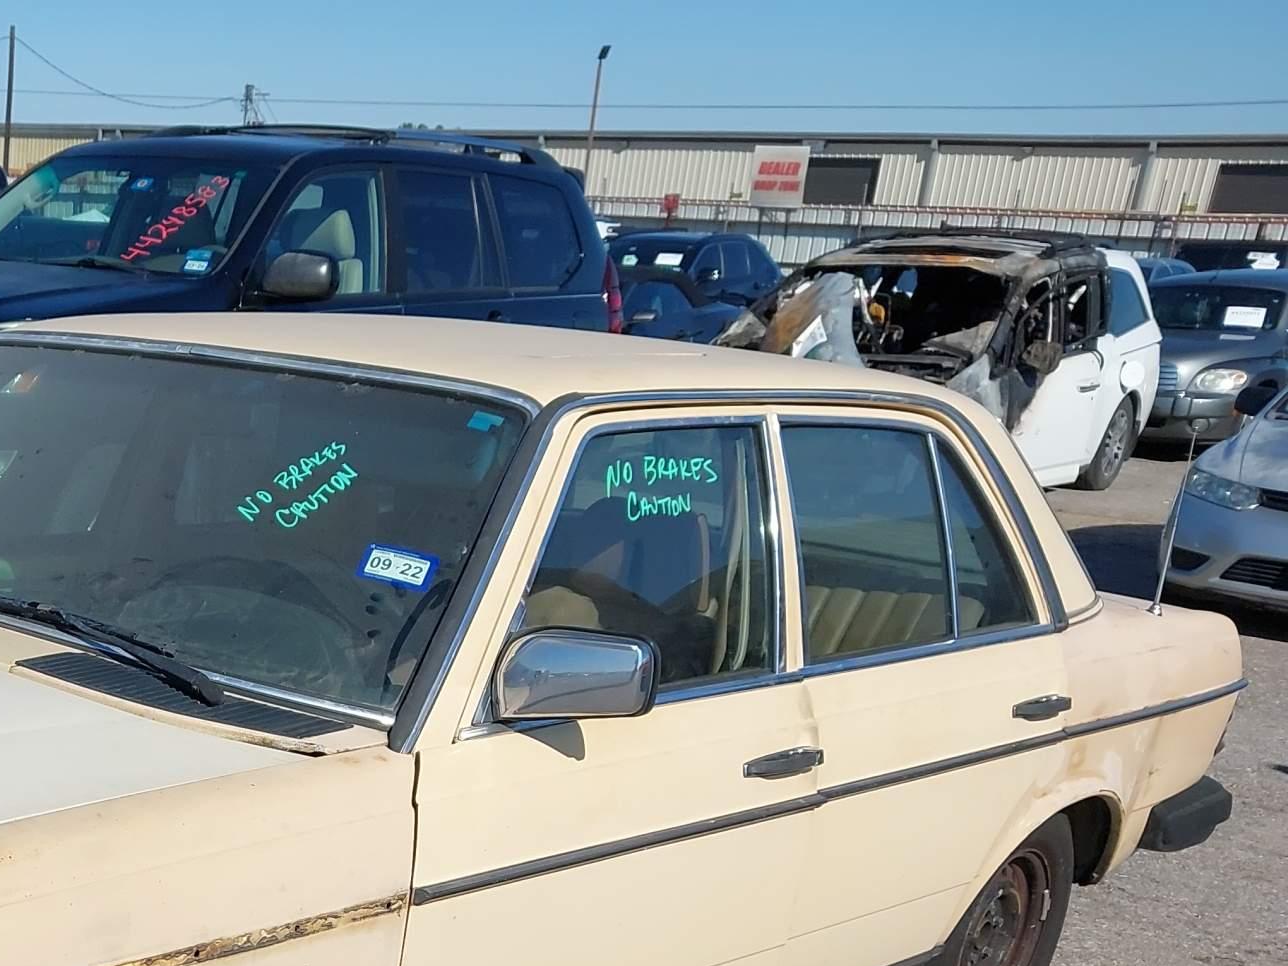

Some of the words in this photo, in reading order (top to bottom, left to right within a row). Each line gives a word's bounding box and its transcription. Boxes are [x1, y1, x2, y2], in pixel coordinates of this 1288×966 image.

[758, 161, 802, 176] DEALER
[236, 490, 273, 522] NO
[273, 441, 346, 490] BRAKES
[275, 462, 358, 528] CAUTION
[605, 460, 633, 498] NO
[643, 456, 718, 485] BRAKES
